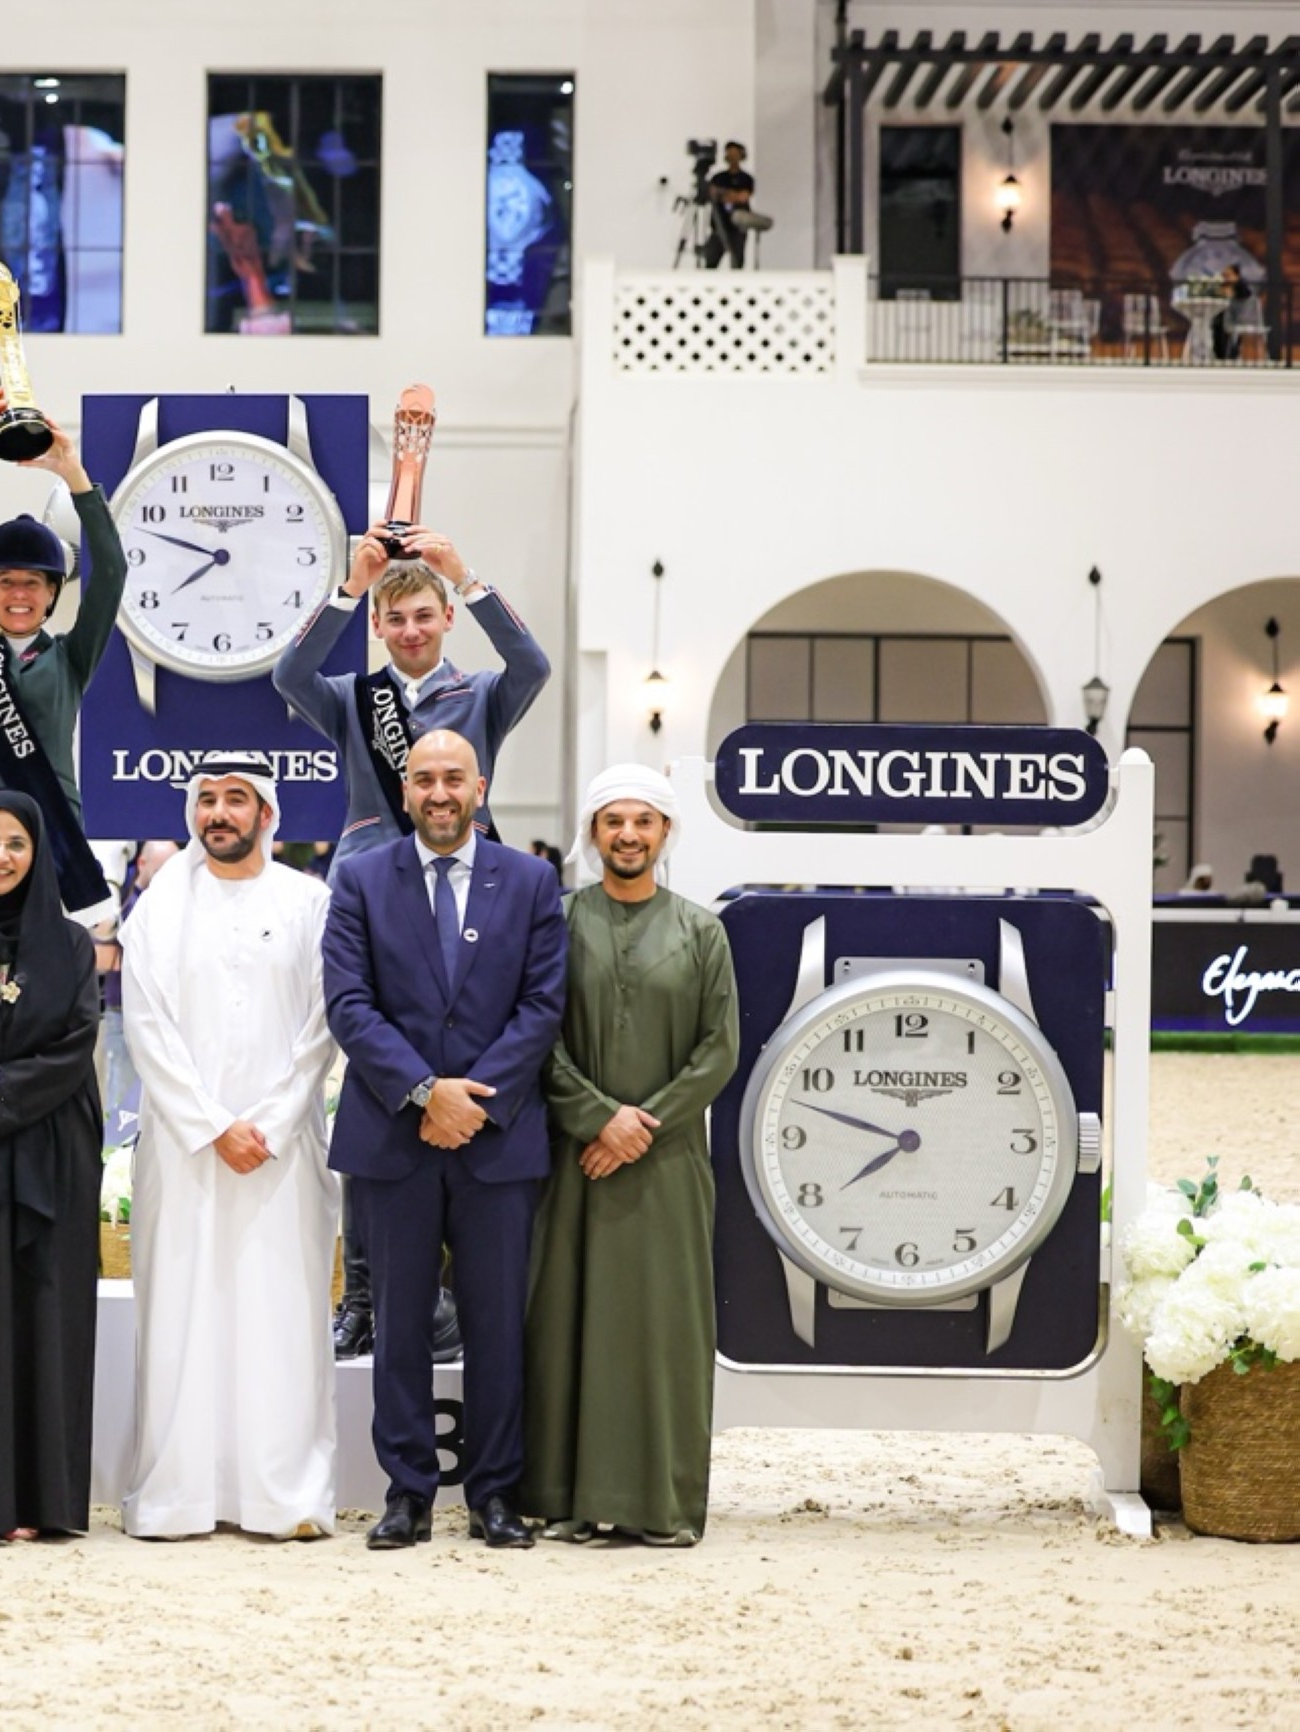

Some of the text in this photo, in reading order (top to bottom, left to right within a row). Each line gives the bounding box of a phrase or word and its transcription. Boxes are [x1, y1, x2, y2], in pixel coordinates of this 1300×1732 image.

[210, 463, 235, 481] 12
[171, 475, 188, 493] 11
[141, 505, 166, 523] 10
[179, 506, 265, 518] LONGINES
[285, 505, 304, 522] 2
[127, 548, 146, 567] 9
[297, 547, 317, 566] 3
[139, 590, 160, 609] 8
[282, 590, 304, 608] 4
[171, 622, 190, 641] 7
[213, 633, 231, 652] 6
[256, 622, 274, 640] 5
[372, 684, 410, 780] ONGIN
[112, 750, 338, 782] LONNES
[738, 747, 1087, 801] LONGINES
[893, 1013, 929, 1038] 12
[843, 1029, 864, 1053] 11
[966, 1031, 975, 1054] 1
[802, 1067, 835, 1092] 10
[853, 1070, 967, 1087] LONGINES
[996, 1070, 1021, 1095] 2
[781, 1125, 807, 1150] 9
[1010, 1128, 1037, 1154] 3
[797, 1183, 823, 1208] 8
[879, 1191, 938, 1200] AUTOMATIC
[989, 1186, 1019, 1211] 4
[839, 1227, 864, 1251] 7
[953, 1228, 977, 1253] 5
[894, 1242, 920, 1267] 6
